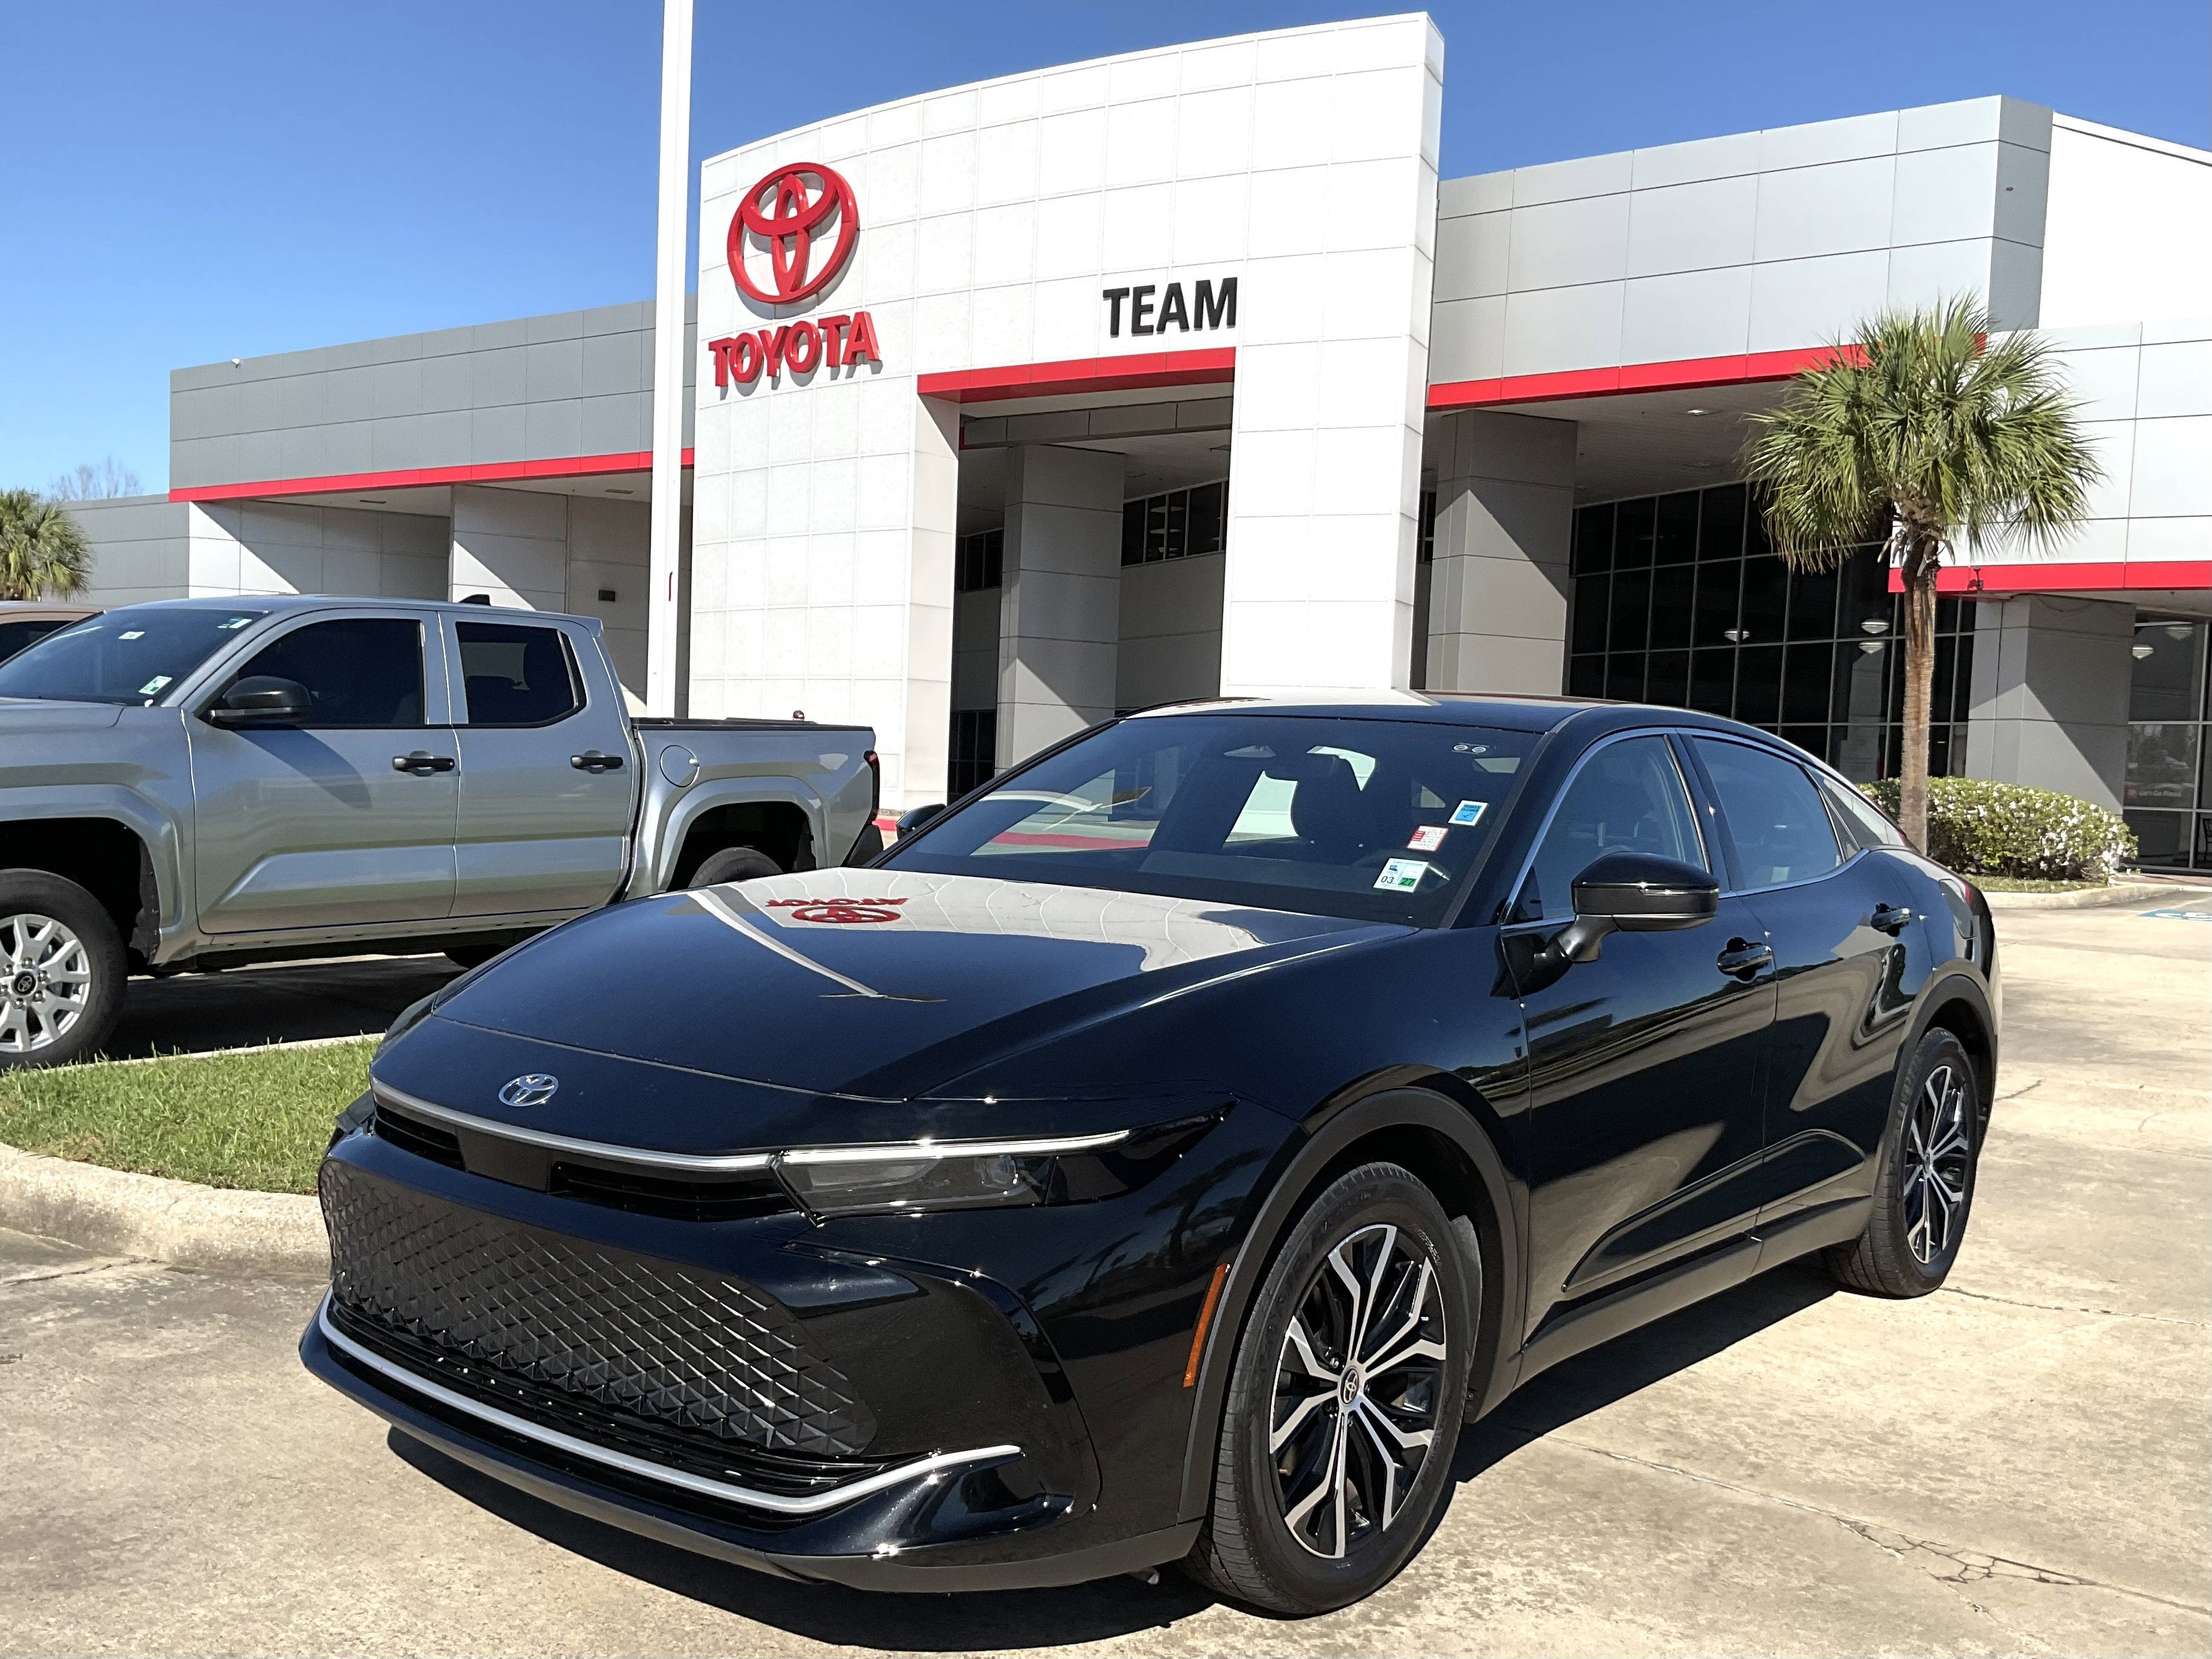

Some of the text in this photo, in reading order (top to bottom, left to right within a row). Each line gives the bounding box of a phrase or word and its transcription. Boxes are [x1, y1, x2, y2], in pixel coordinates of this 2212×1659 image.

[1103, 277, 1237, 337] TEAM
[709, 311, 881, 386] TOYOTA
[1400, 878, 1416, 886] 27
